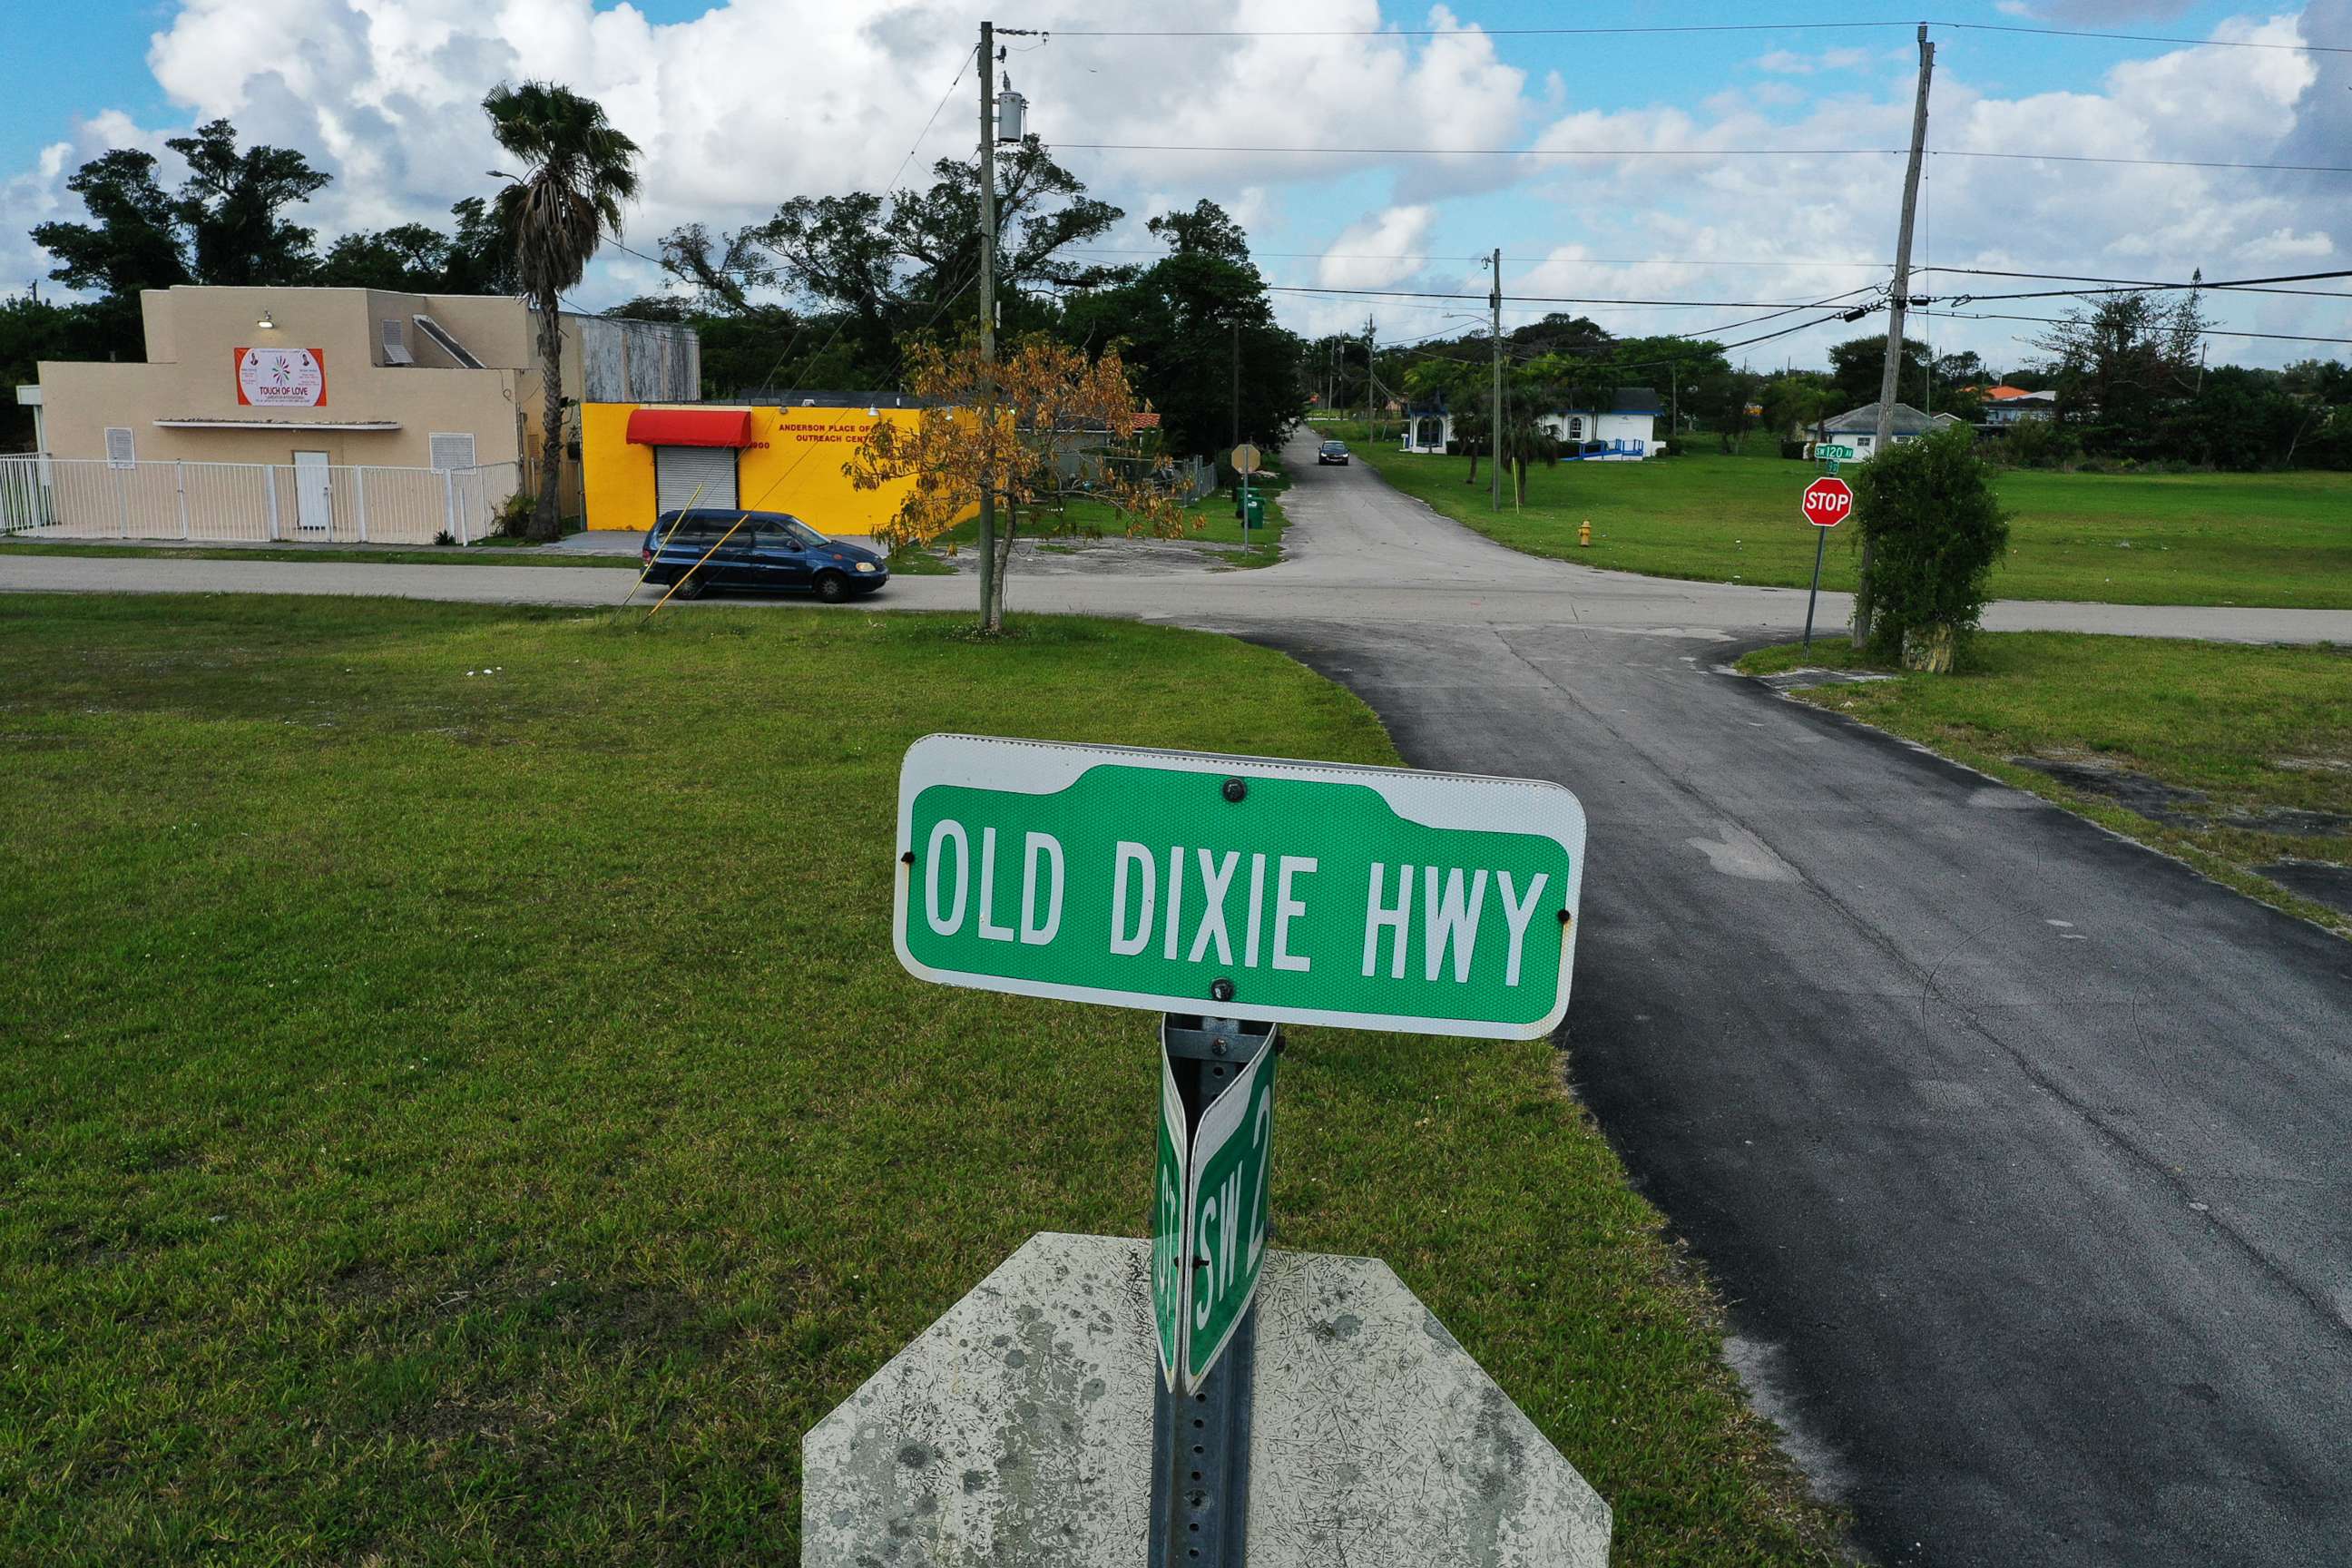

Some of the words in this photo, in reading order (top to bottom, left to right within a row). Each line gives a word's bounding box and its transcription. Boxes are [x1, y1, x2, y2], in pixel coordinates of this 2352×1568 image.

[281, 387, 290, 396] OF
[779, 424, 826, 432] ANDERSON
[828, 424, 856, 433] PLACE
[858, 425, 870, 433] OF
[796, 435, 842, 443] OUTREACH
[1817, 447, 1825, 456] SW
[1826, 446, 1843, 458] 120
[1807, 491, 1848, 512] STOP
[924, 818, 1065, 946] OLD
[1109, 840, 1318, 973] DIXIE
[1361, 861, 1551, 987] HWY
[1195, 1160, 1244, 1331] SW
